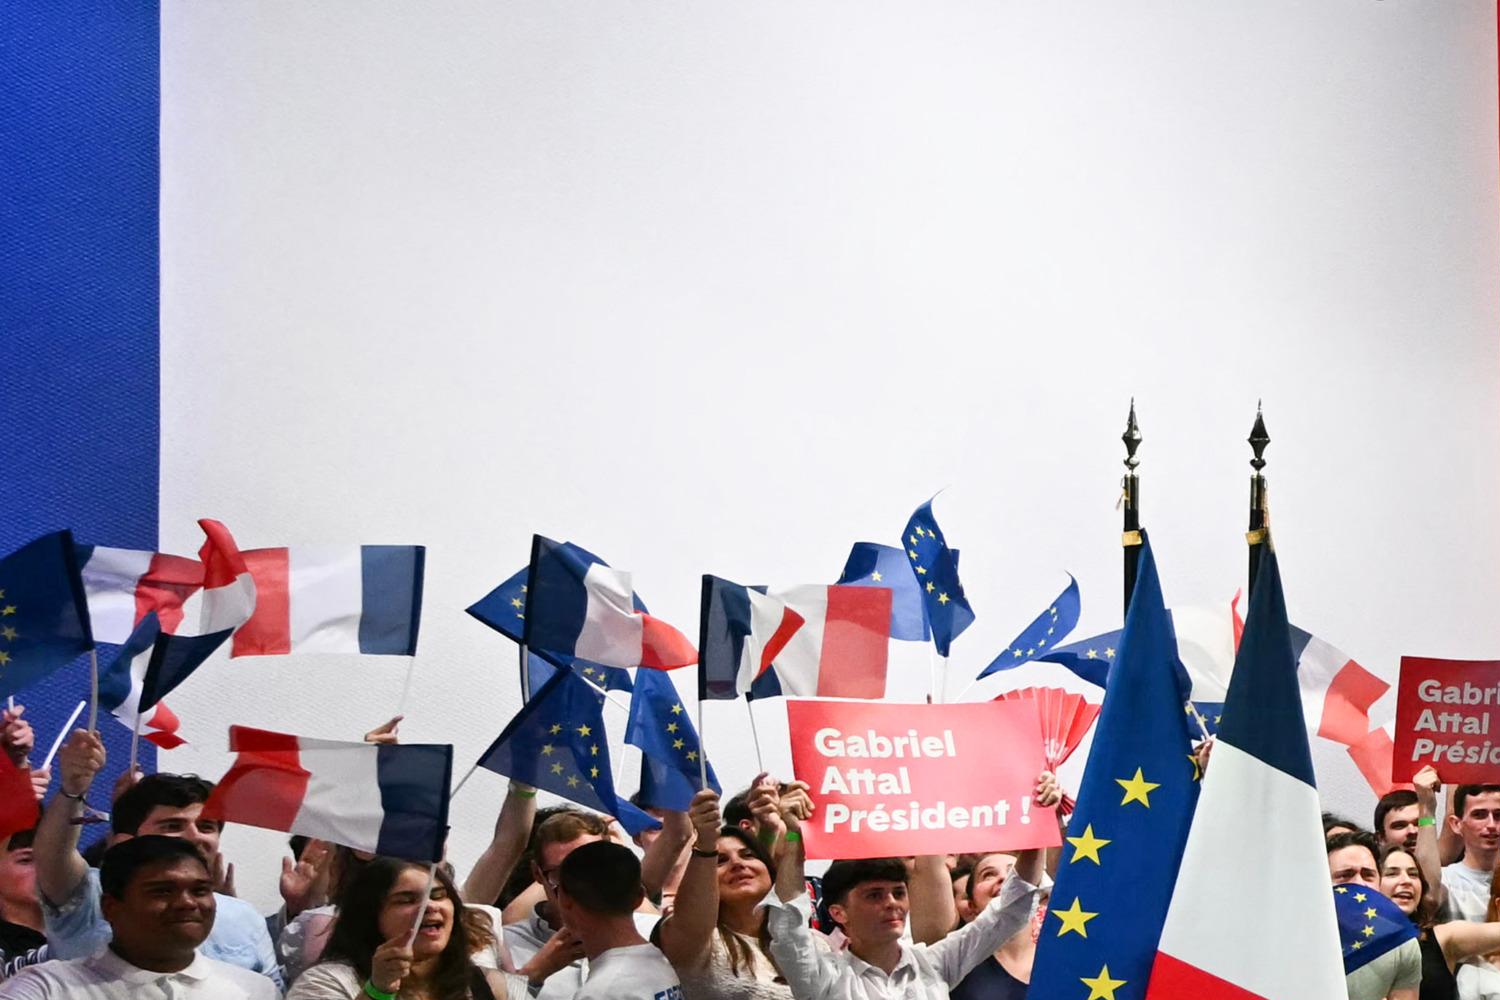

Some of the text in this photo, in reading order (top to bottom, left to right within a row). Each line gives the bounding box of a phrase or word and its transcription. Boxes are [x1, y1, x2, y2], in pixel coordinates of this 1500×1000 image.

[1414, 709, 1490, 735] Attal
[814, 727, 957, 759] Gabriel
[820, 765, 912, 795] Attal
[824, 796, 1031, 833] Président !
